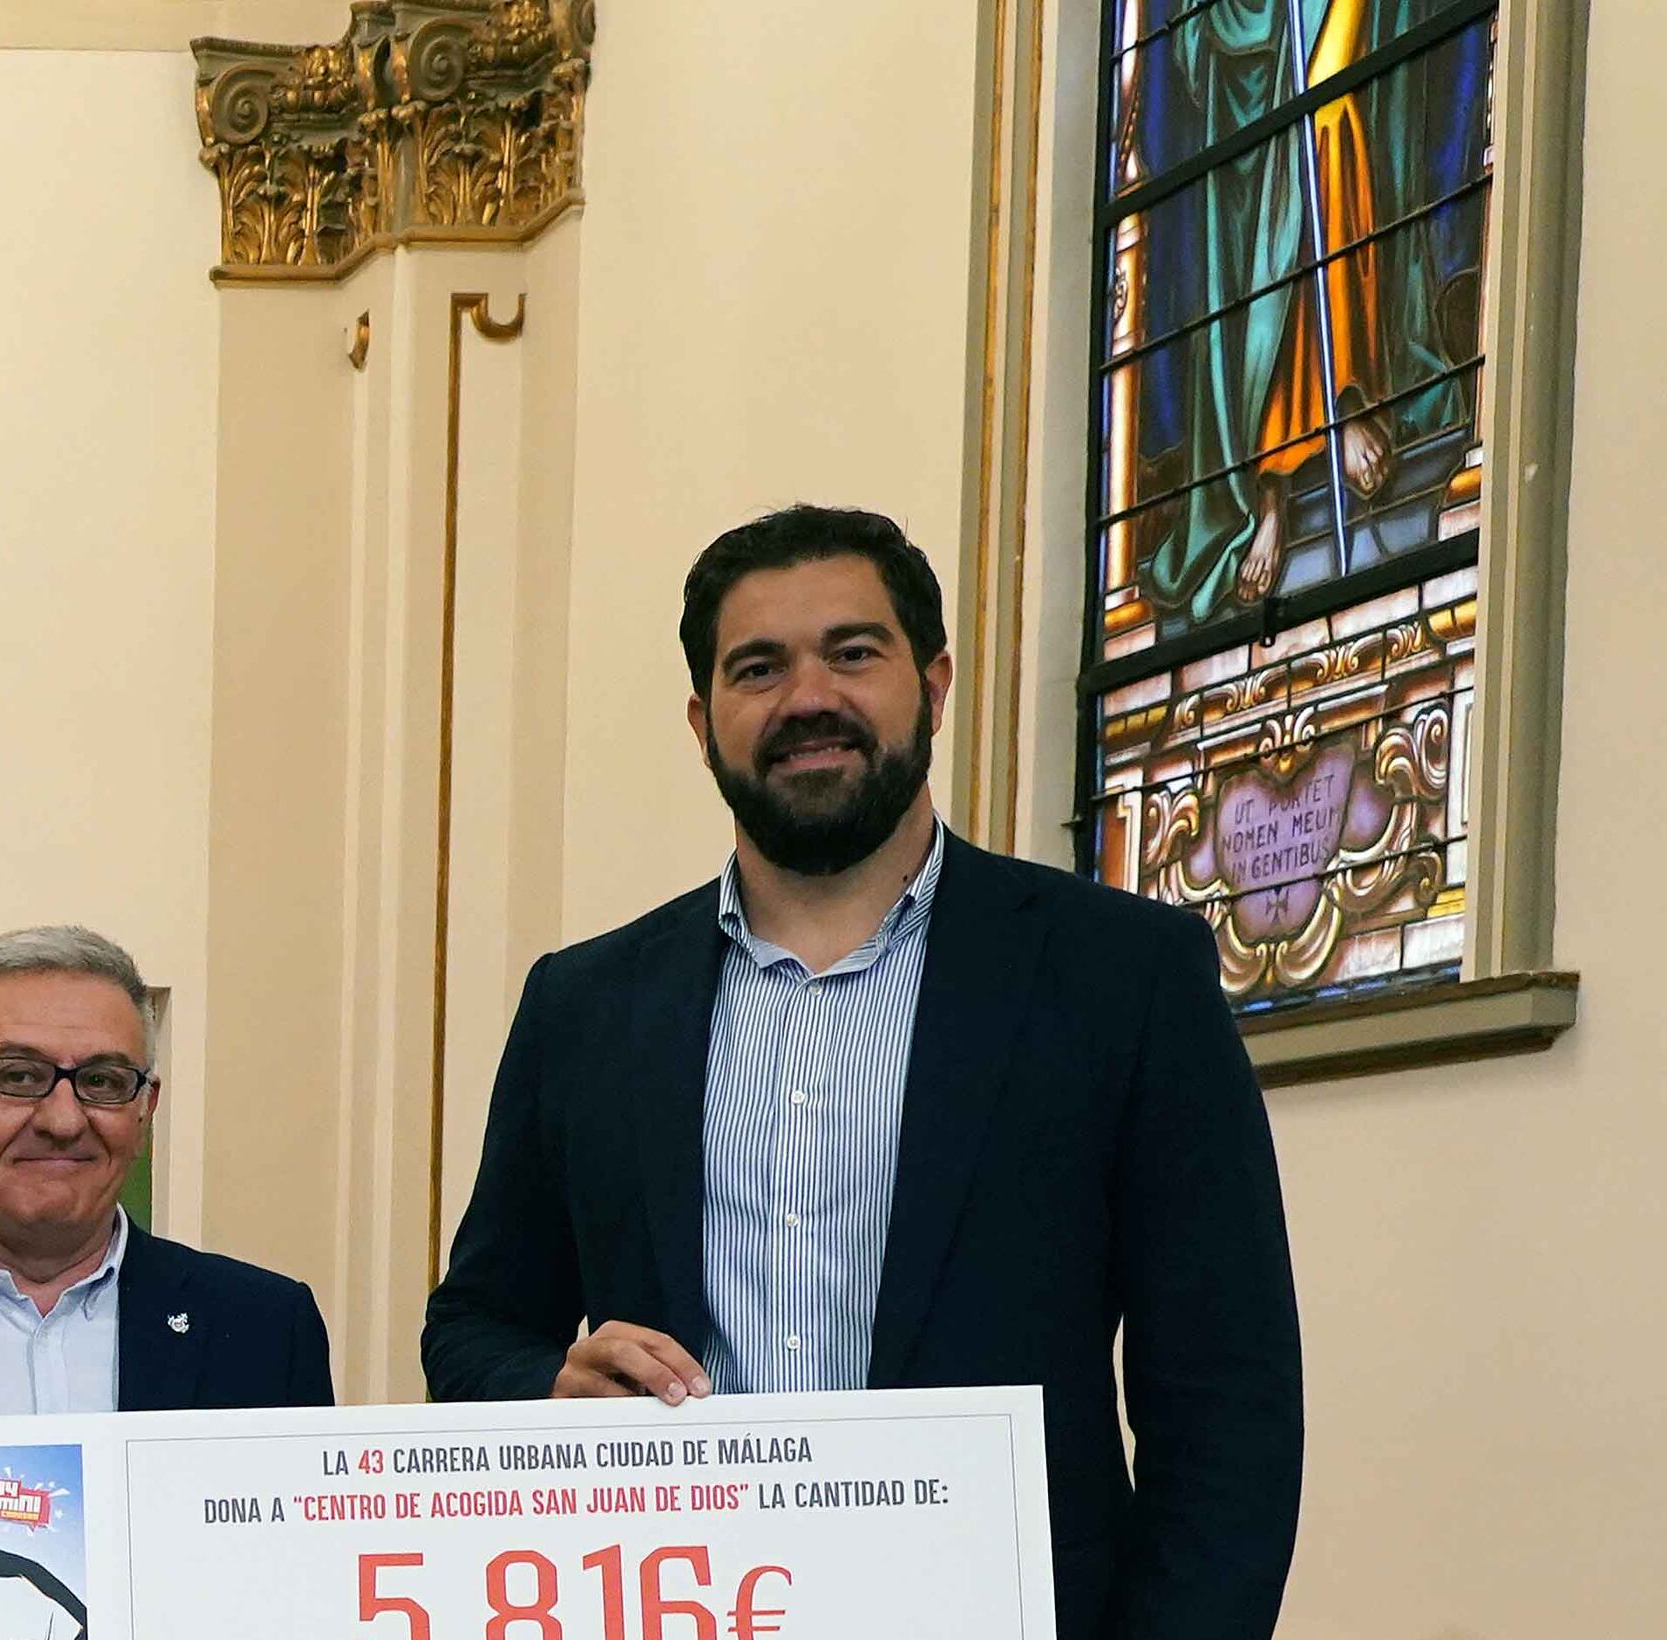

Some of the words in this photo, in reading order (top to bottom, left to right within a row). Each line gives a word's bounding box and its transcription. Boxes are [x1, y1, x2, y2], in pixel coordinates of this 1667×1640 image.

[1235, 799, 1254, 824] UT
[323, 1451, 349, 1475] LA
[358, 1449, 384, 1475] 43
[393, 1446, 489, 1473] CARRERA
[499, 1443, 587, 1470] URBANA
[597, 1440, 674, 1468] CIUDAD
[683, 1440, 708, 1466] DE
[718, 1433, 813, 1466] MÁLAGA
[204, 1498, 262, 1524] DONA
[271, 1498, 285, 1521] A
[396, 1493, 421, 1519] DE
[431, 1490, 523, 1519] ACOGIDA
[533, 1488, 577, 1515] SAN
[586, 1485, 645, 1515] JUAN
[655, 1485, 681, 1512] DE
[759, 1483, 785, 1510] LA
[795, 1480, 905, 1509] CANTIDAD
[914, 1479, 948, 1506] DE:
